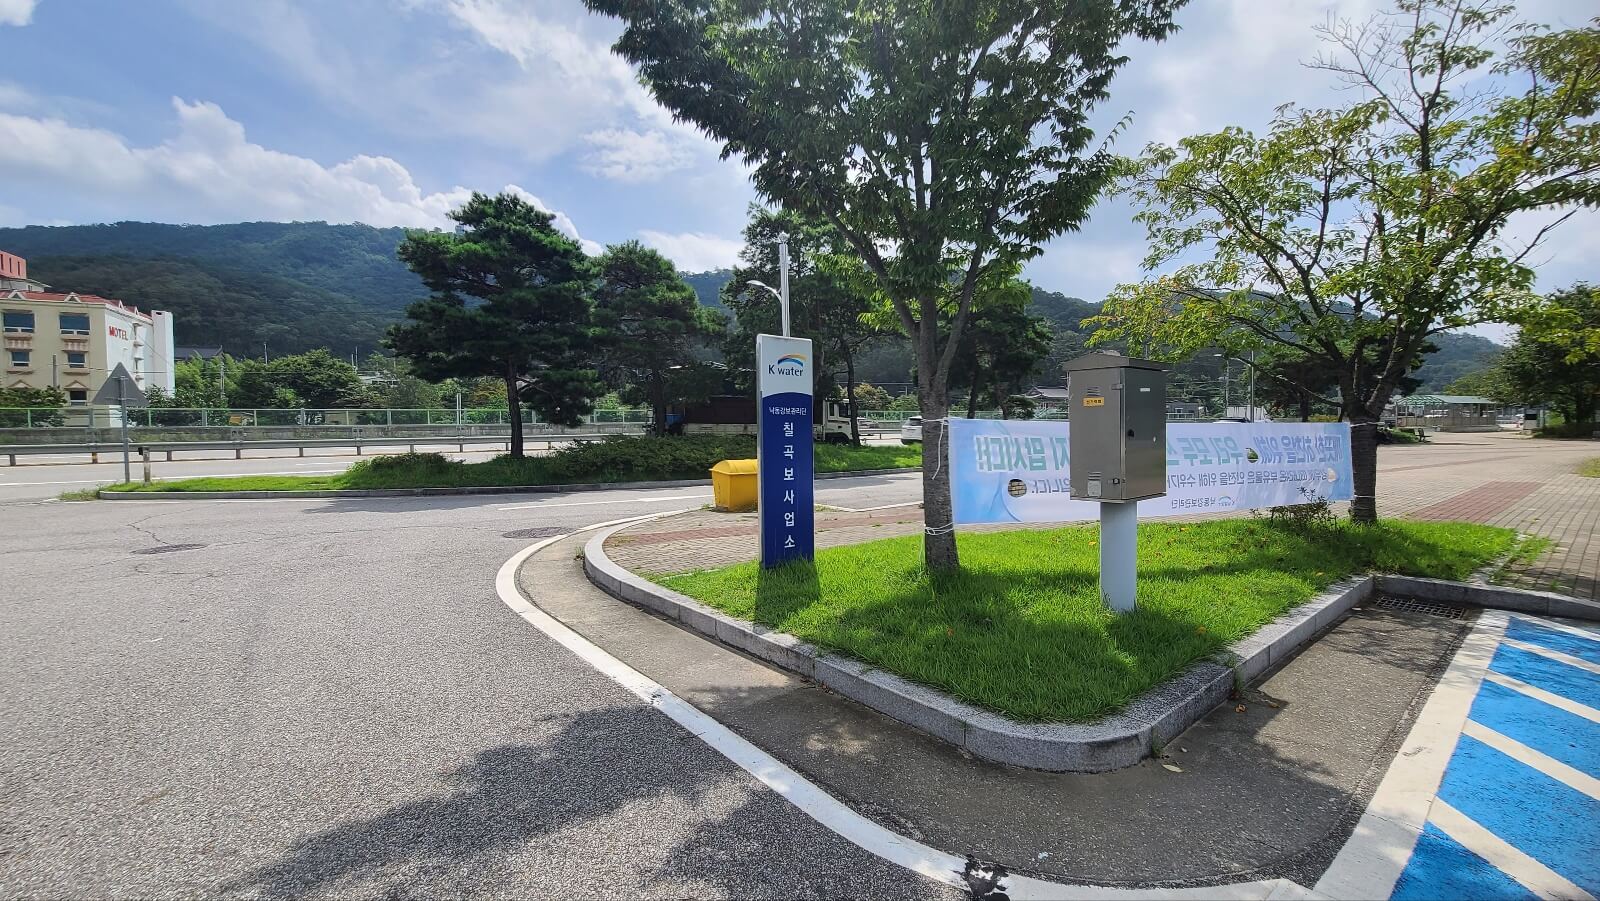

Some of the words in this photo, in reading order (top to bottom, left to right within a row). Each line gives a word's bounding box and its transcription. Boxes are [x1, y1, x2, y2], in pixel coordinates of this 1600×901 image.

[108, 325, 129, 341] MOTEL
[777, 365, 804, 377] water
[768, 406, 807, 416] 낙동강보관리단
